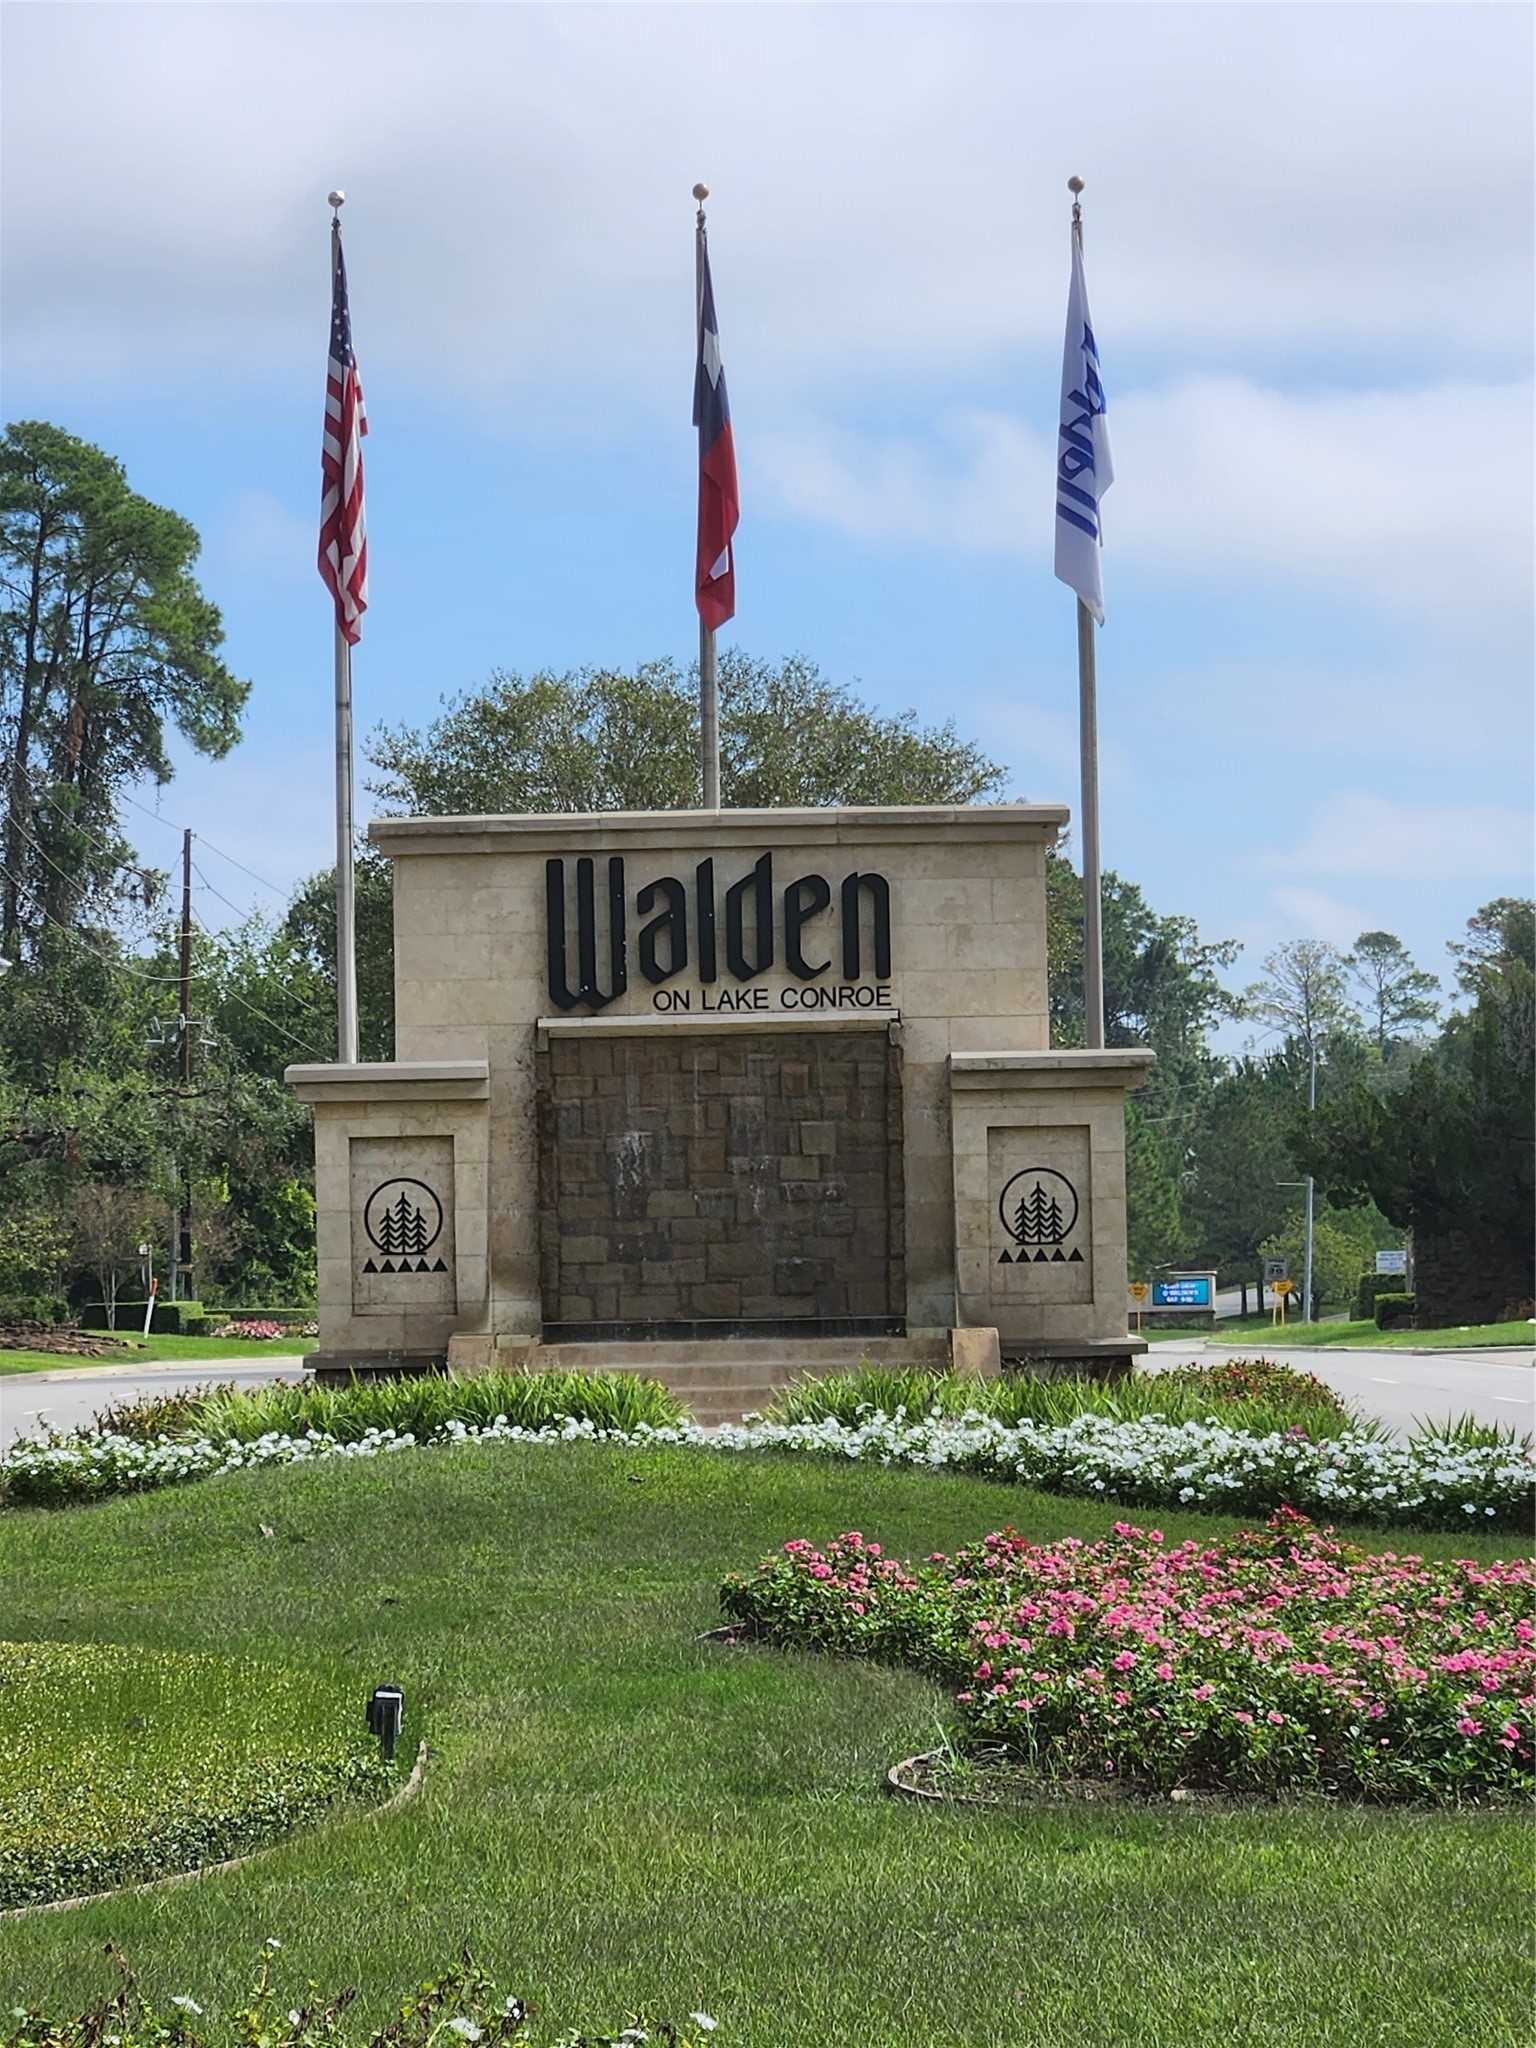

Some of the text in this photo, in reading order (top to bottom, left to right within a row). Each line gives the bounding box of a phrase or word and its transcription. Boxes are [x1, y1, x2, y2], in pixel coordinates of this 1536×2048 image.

[546, 851, 892, 1011] Walden
[653, 986, 892, 1011] ON LAKE CONROE
